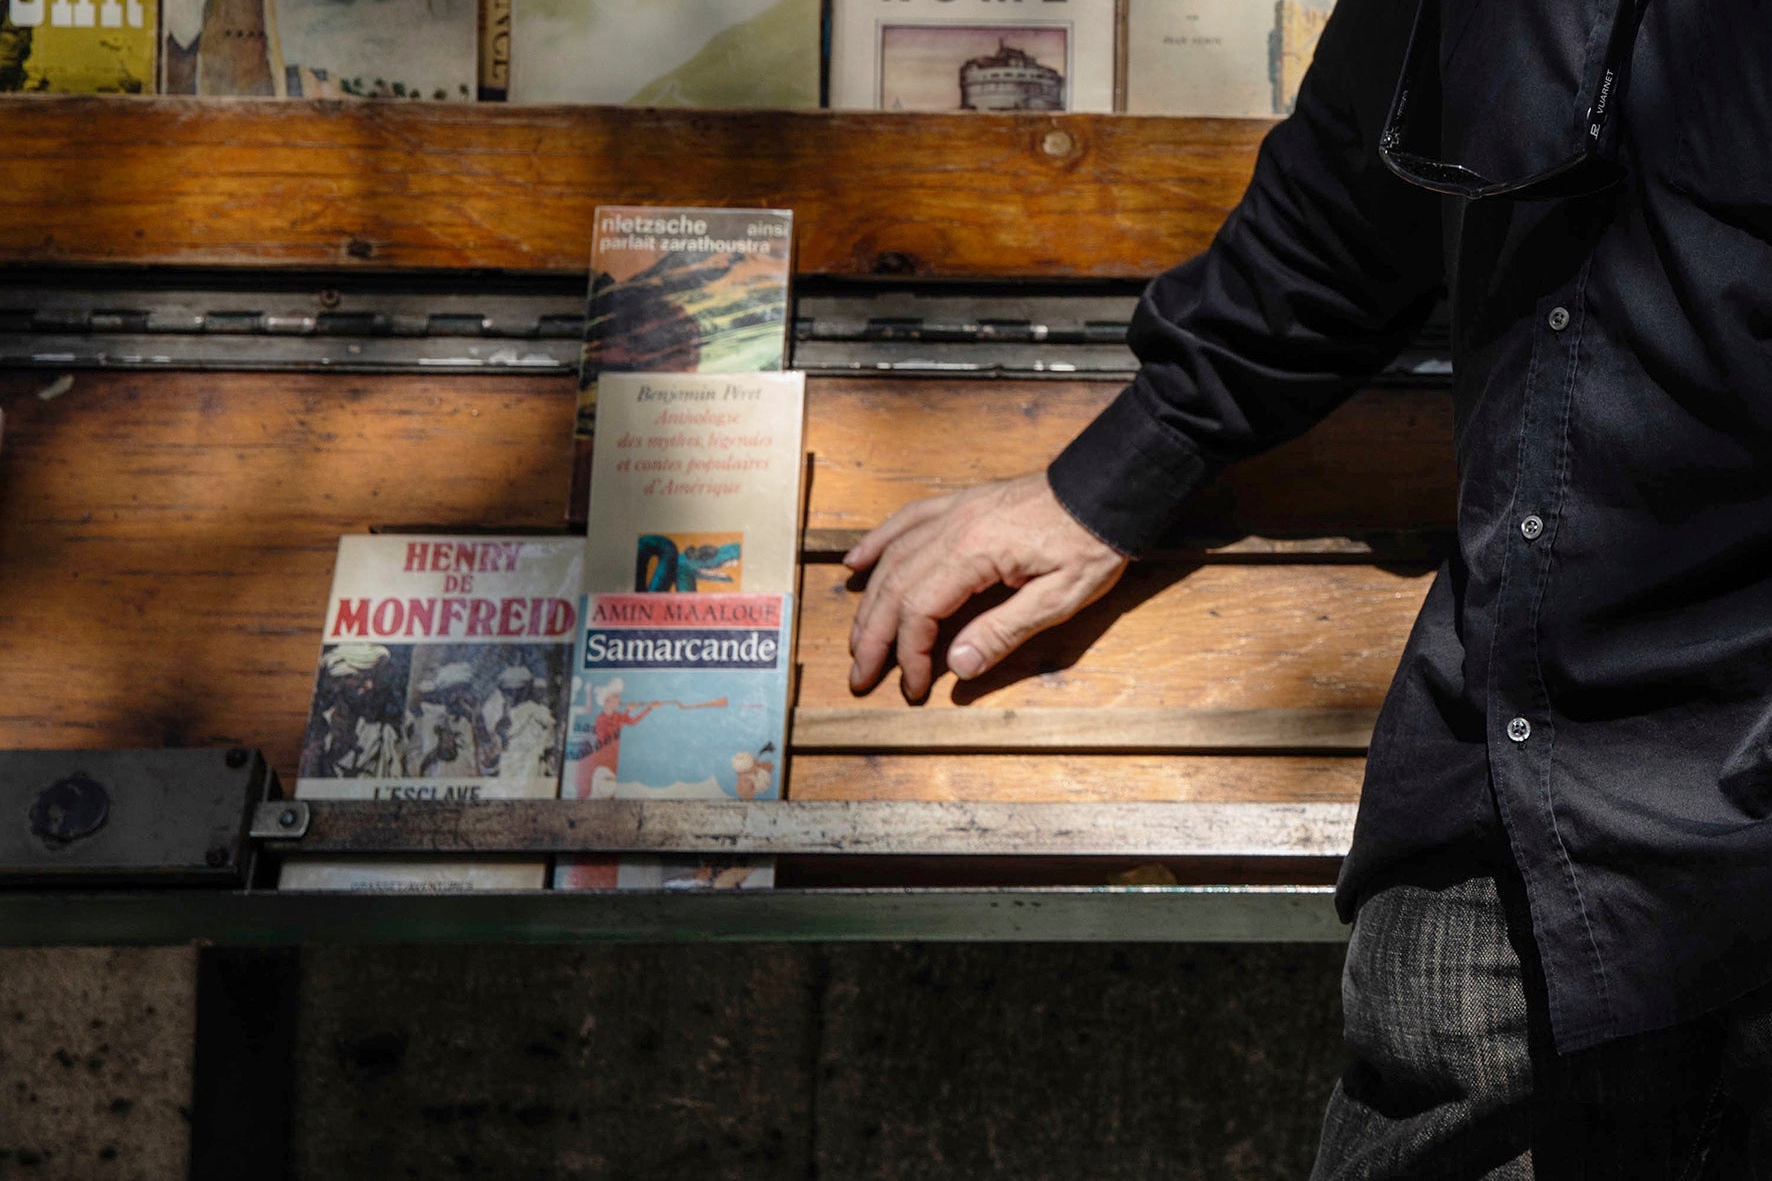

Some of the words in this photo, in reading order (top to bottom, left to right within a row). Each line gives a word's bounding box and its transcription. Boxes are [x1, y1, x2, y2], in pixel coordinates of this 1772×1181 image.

[600, 213, 708, 235] nietzsche
[746, 220, 790, 238] ainsi
[403, 541, 526, 573] HENRY
[442, 573, 475, 595] DE
[331, 596, 578, 638] MONFREID
[591, 603, 655, 623] AMIN
[663, 604, 778, 623] MAALOUF
[586, 632, 778, 664] Samarcande
